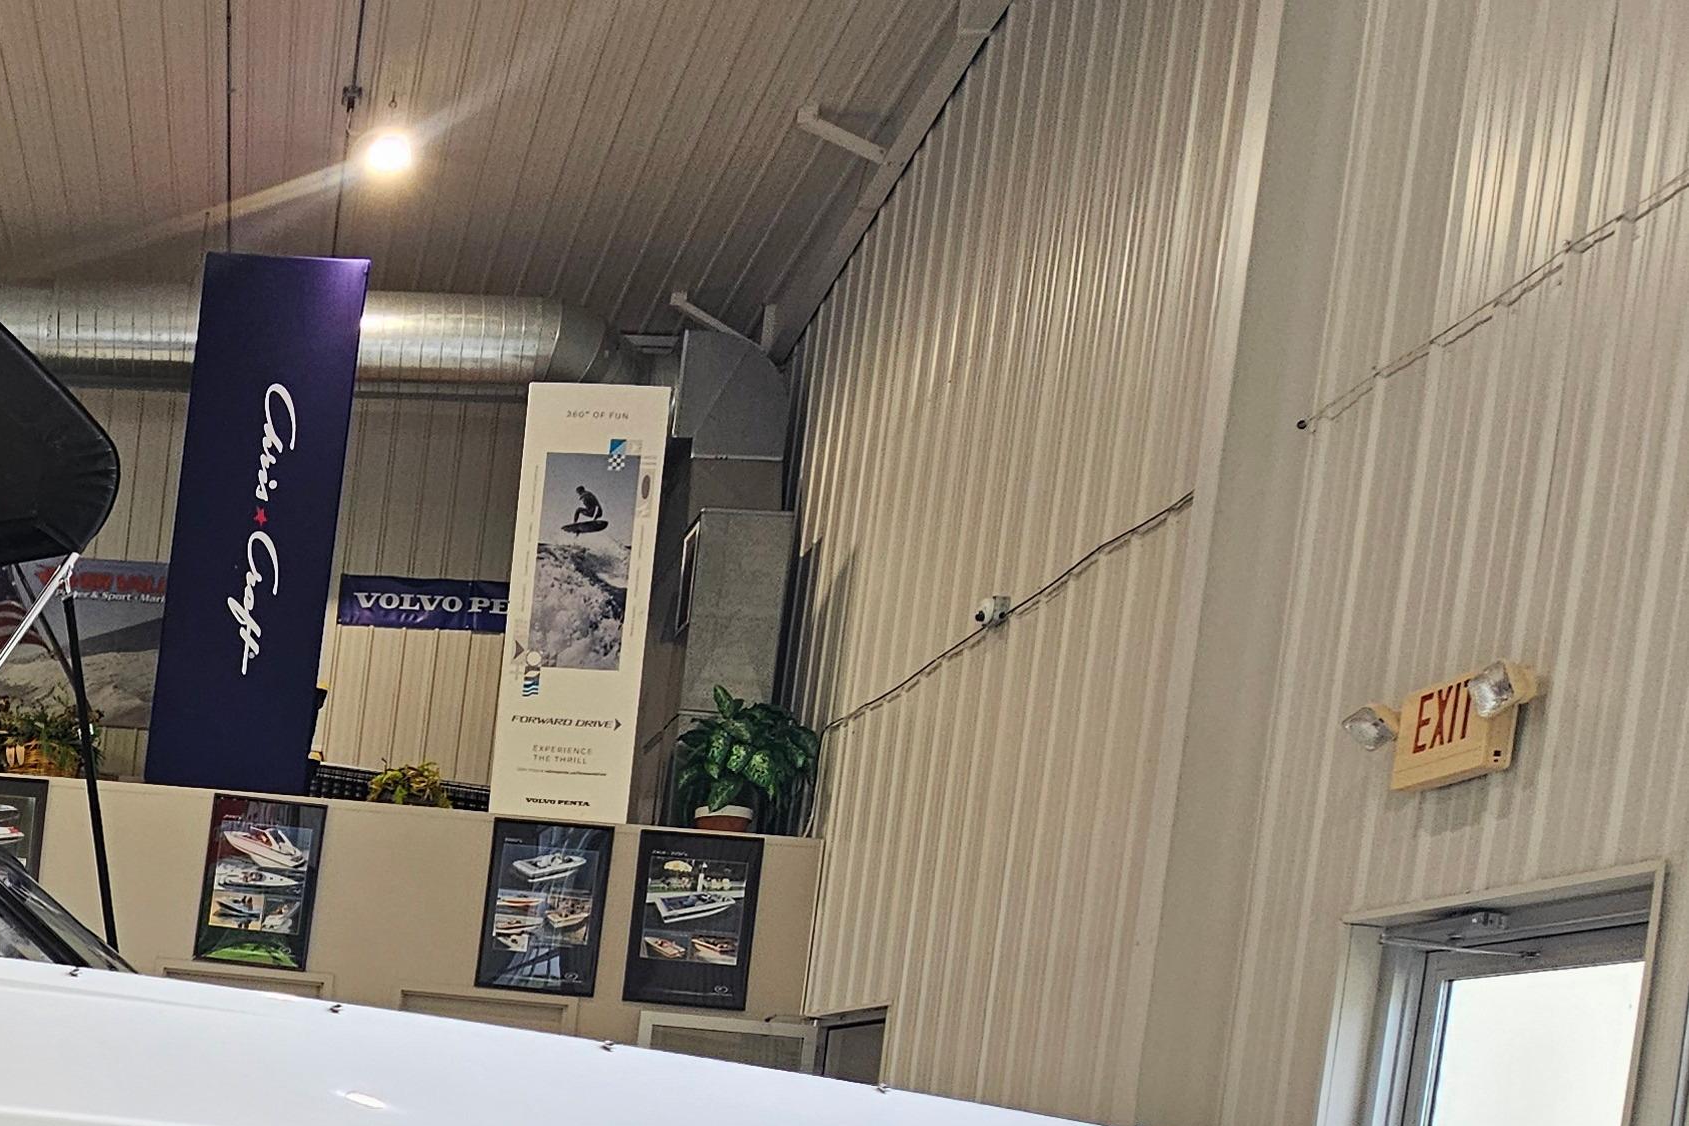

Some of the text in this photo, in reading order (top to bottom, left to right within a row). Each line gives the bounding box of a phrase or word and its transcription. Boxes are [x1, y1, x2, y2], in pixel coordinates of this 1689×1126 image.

[592, 411, 606, 419] OF
[227, 383, 297, 675] Chris Craft
[101, 591, 132, 602] Sport
[353, 592, 463, 613] VOLVO
[511, 714, 614, 729] FORWARD DRIVE
[1412, 679, 1472, 754] EXIT
[532, 745, 593, 756] EXPERIENCE
[533, 754, 588, 765] THE THRILL
[525, 797, 590, 807] VOLVO PENTA
